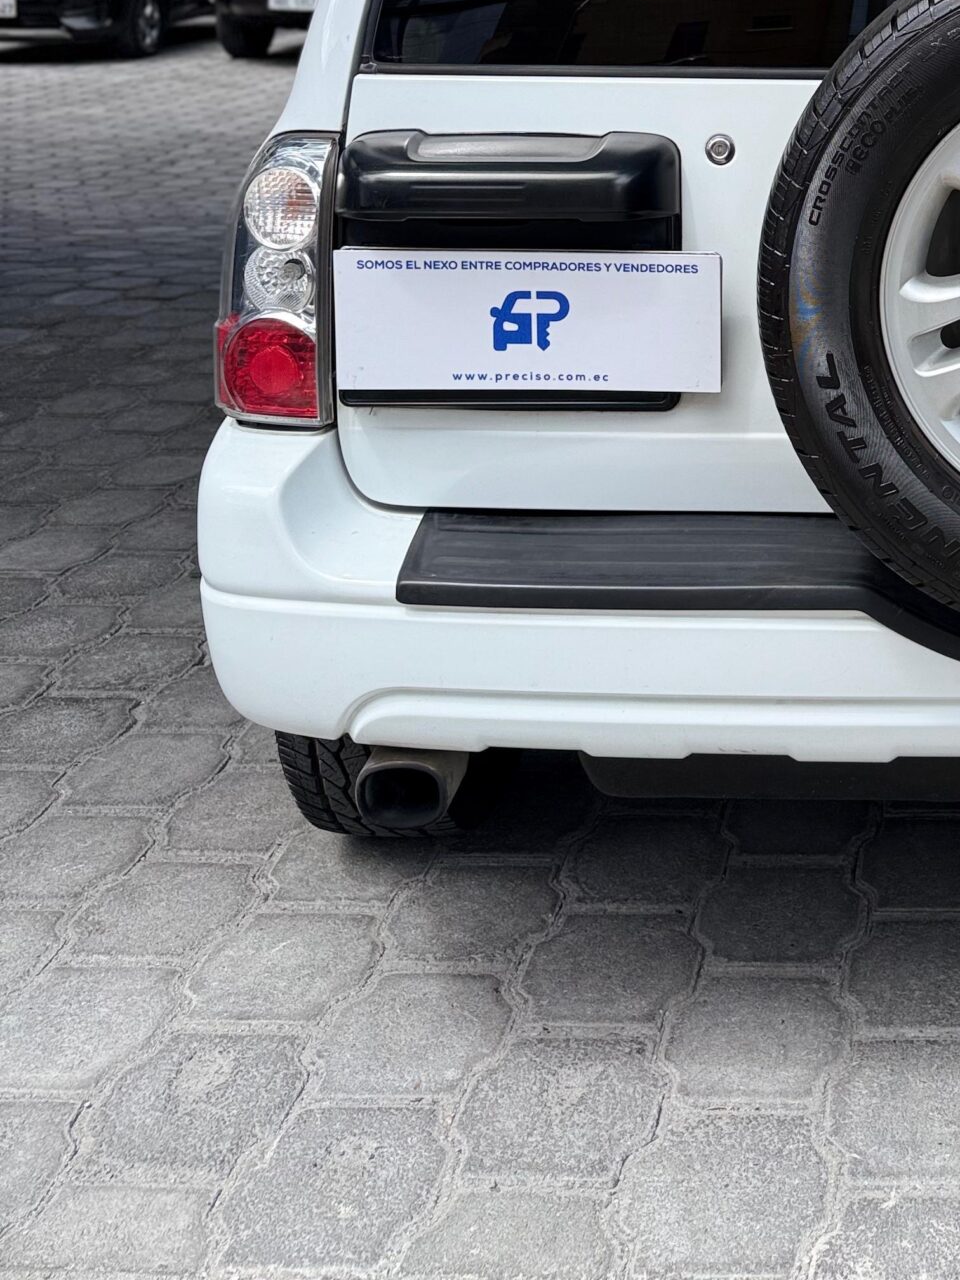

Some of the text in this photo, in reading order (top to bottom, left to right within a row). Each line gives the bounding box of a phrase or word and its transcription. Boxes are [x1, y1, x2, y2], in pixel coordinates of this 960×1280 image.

[356, 259, 699, 274] SOMOS EL NEXO ENTRE COMPRADORES Y VENDEDORES
[452, 371, 609, 383] www.preciso.com.ec
